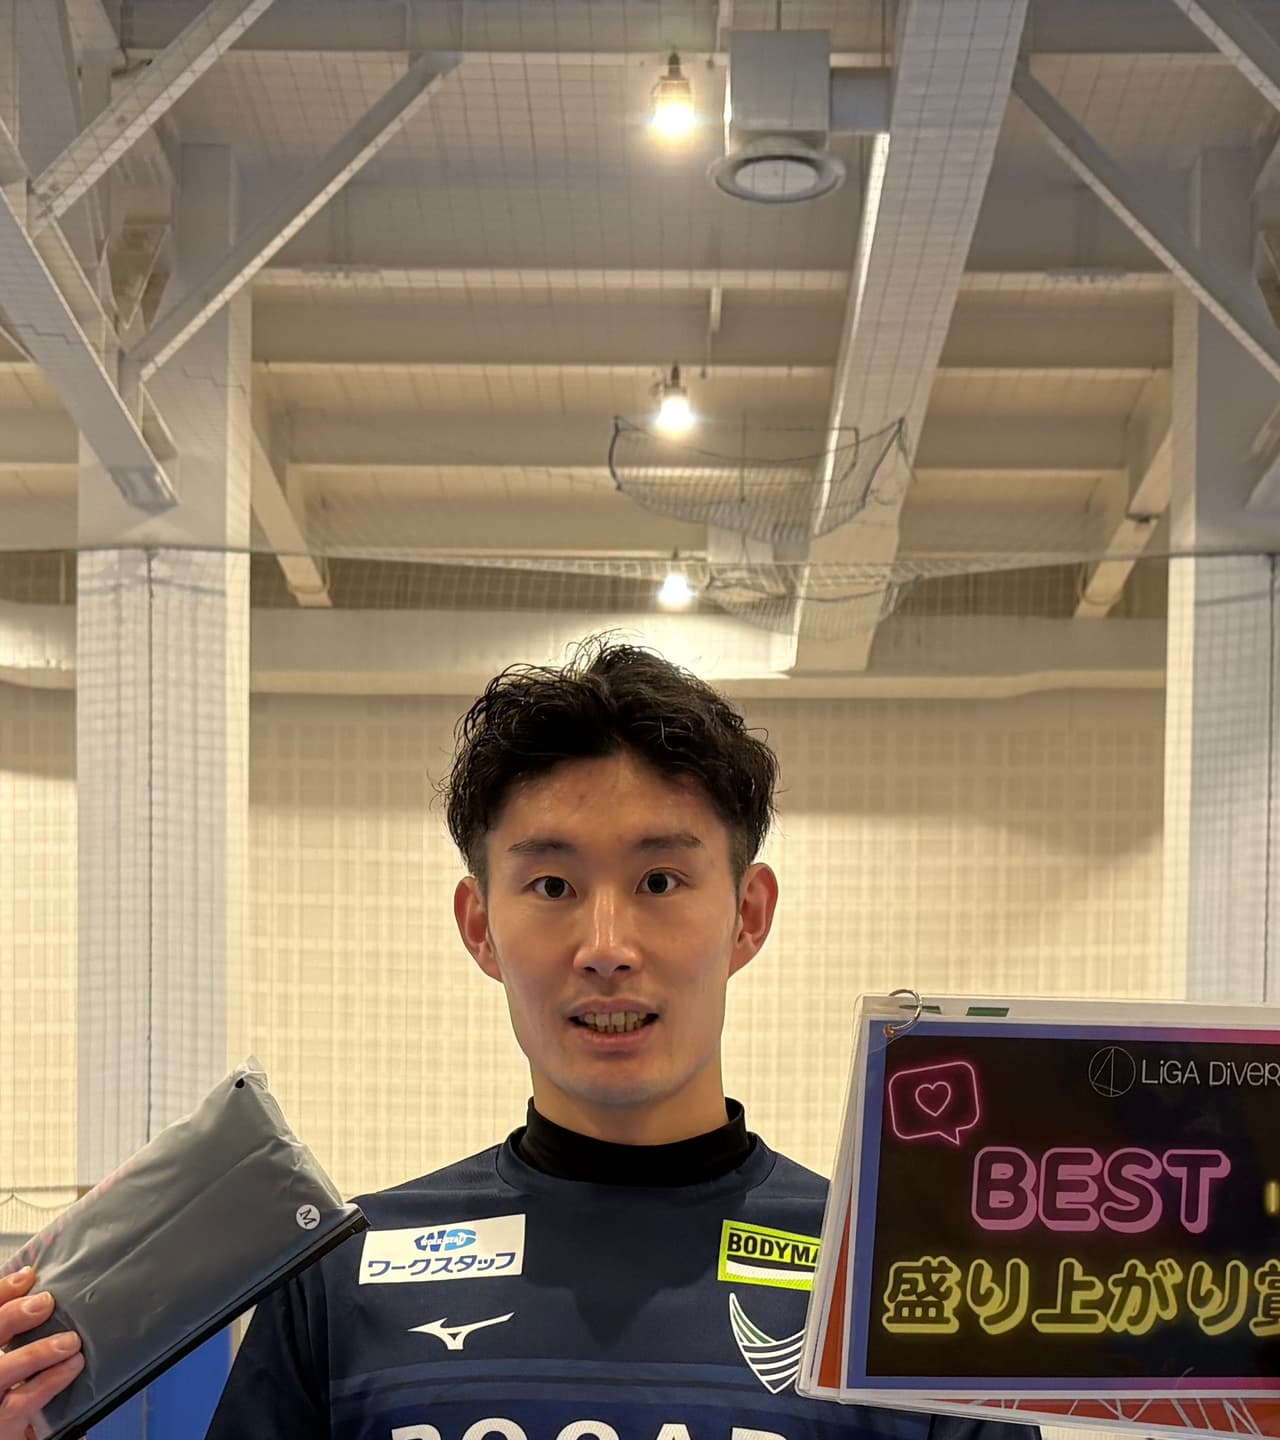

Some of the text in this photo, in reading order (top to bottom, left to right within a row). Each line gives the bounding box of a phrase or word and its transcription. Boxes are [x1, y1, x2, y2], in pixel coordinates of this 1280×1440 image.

[971, 1146, 1231, 1234] BEST
[299, 1207, 317, 1227] M
[367, 1252, 516, 1277] ワークスタッフ
